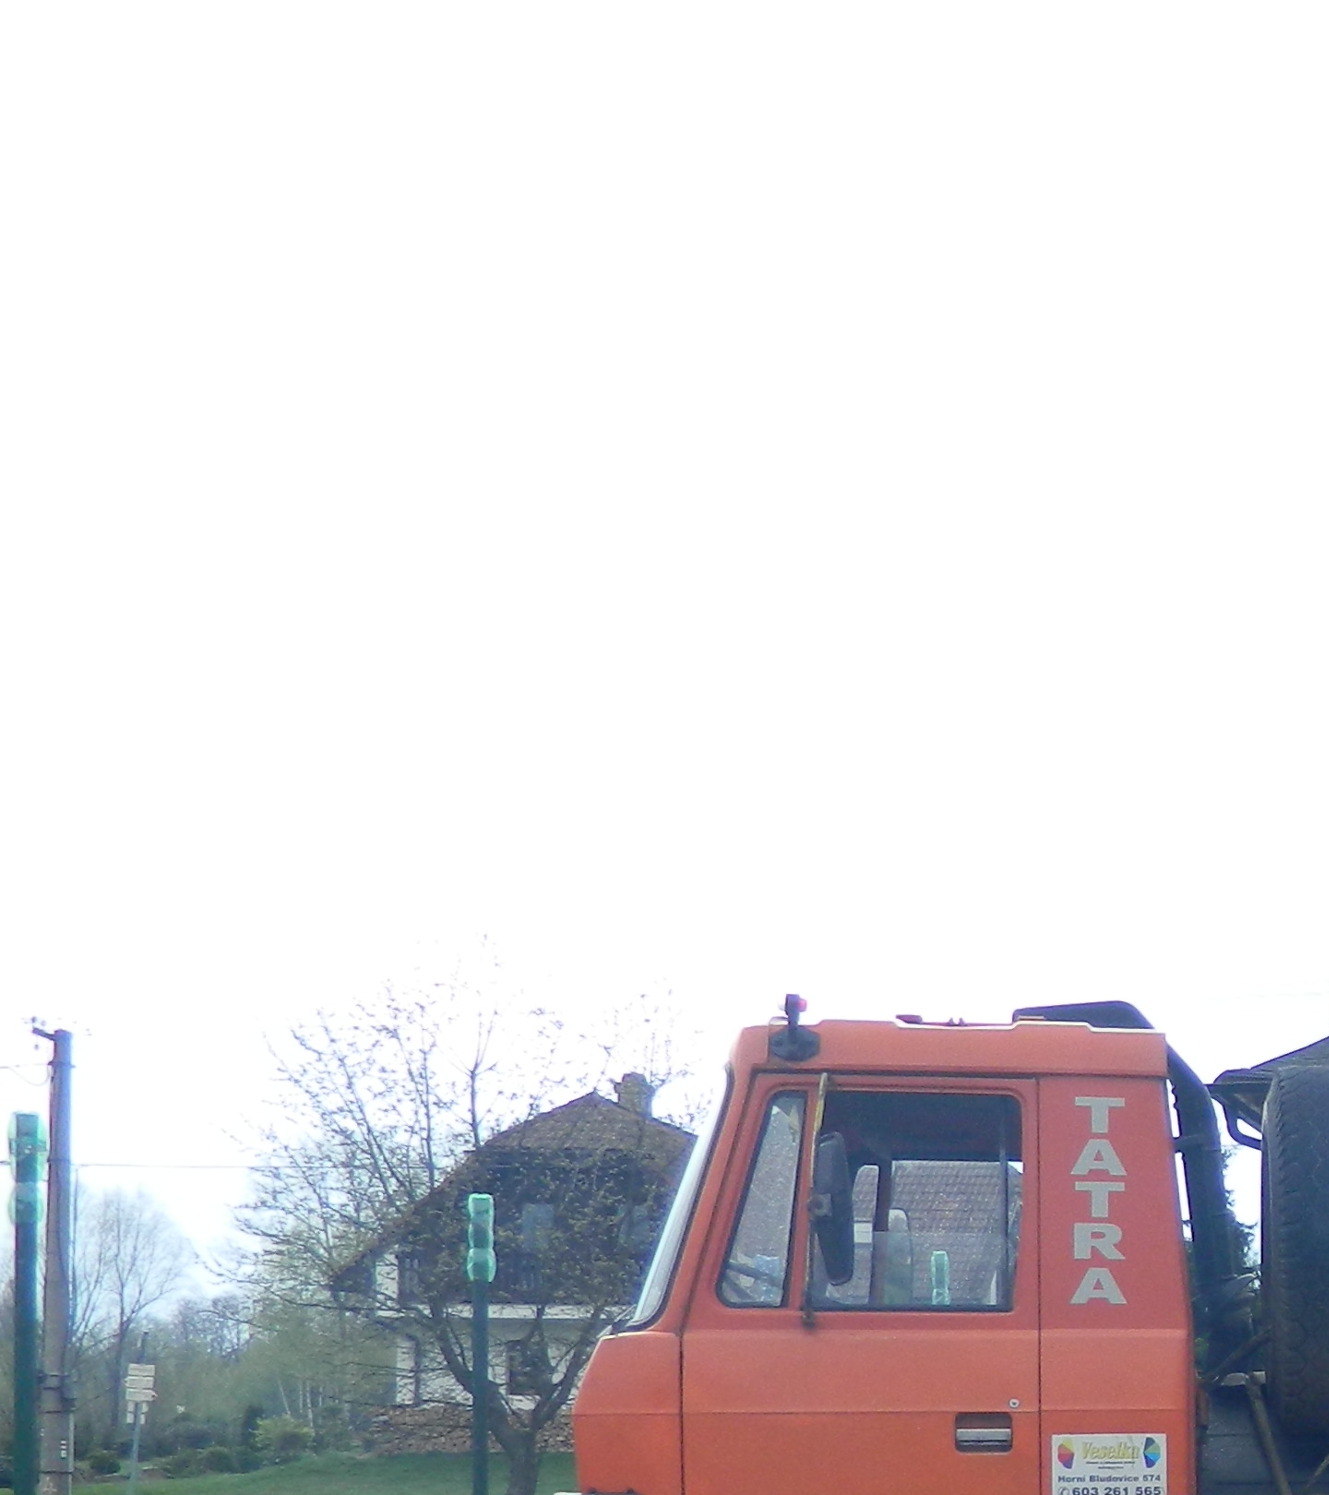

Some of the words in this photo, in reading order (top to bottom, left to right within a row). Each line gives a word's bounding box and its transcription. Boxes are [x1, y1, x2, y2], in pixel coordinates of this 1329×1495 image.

[1070, 1096, 1128, 1305] TATRA
[1089, 1474, 1139, 1483] Bludovice
[1143, 1474, 1161, 1482] 574
[1135, 1486, 1161, 1495] 565
